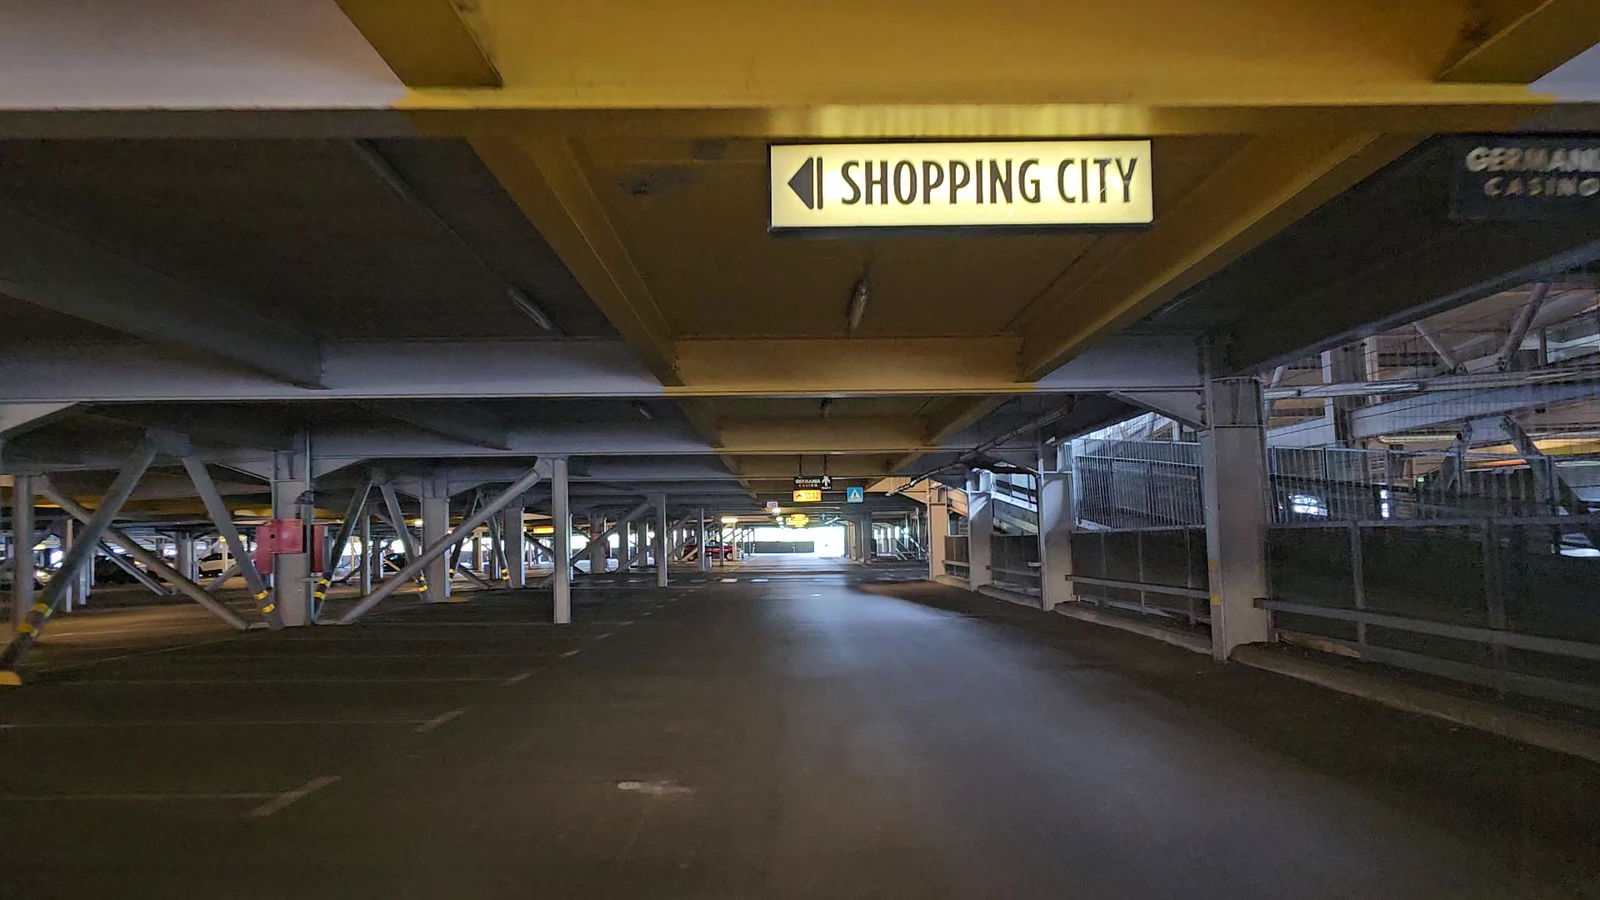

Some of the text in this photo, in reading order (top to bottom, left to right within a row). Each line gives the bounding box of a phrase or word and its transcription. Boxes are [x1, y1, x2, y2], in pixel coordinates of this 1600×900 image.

[840, 156, 1139, 206] SHOPPING CITY
[1484, 176, 1600, 197] CASINO
